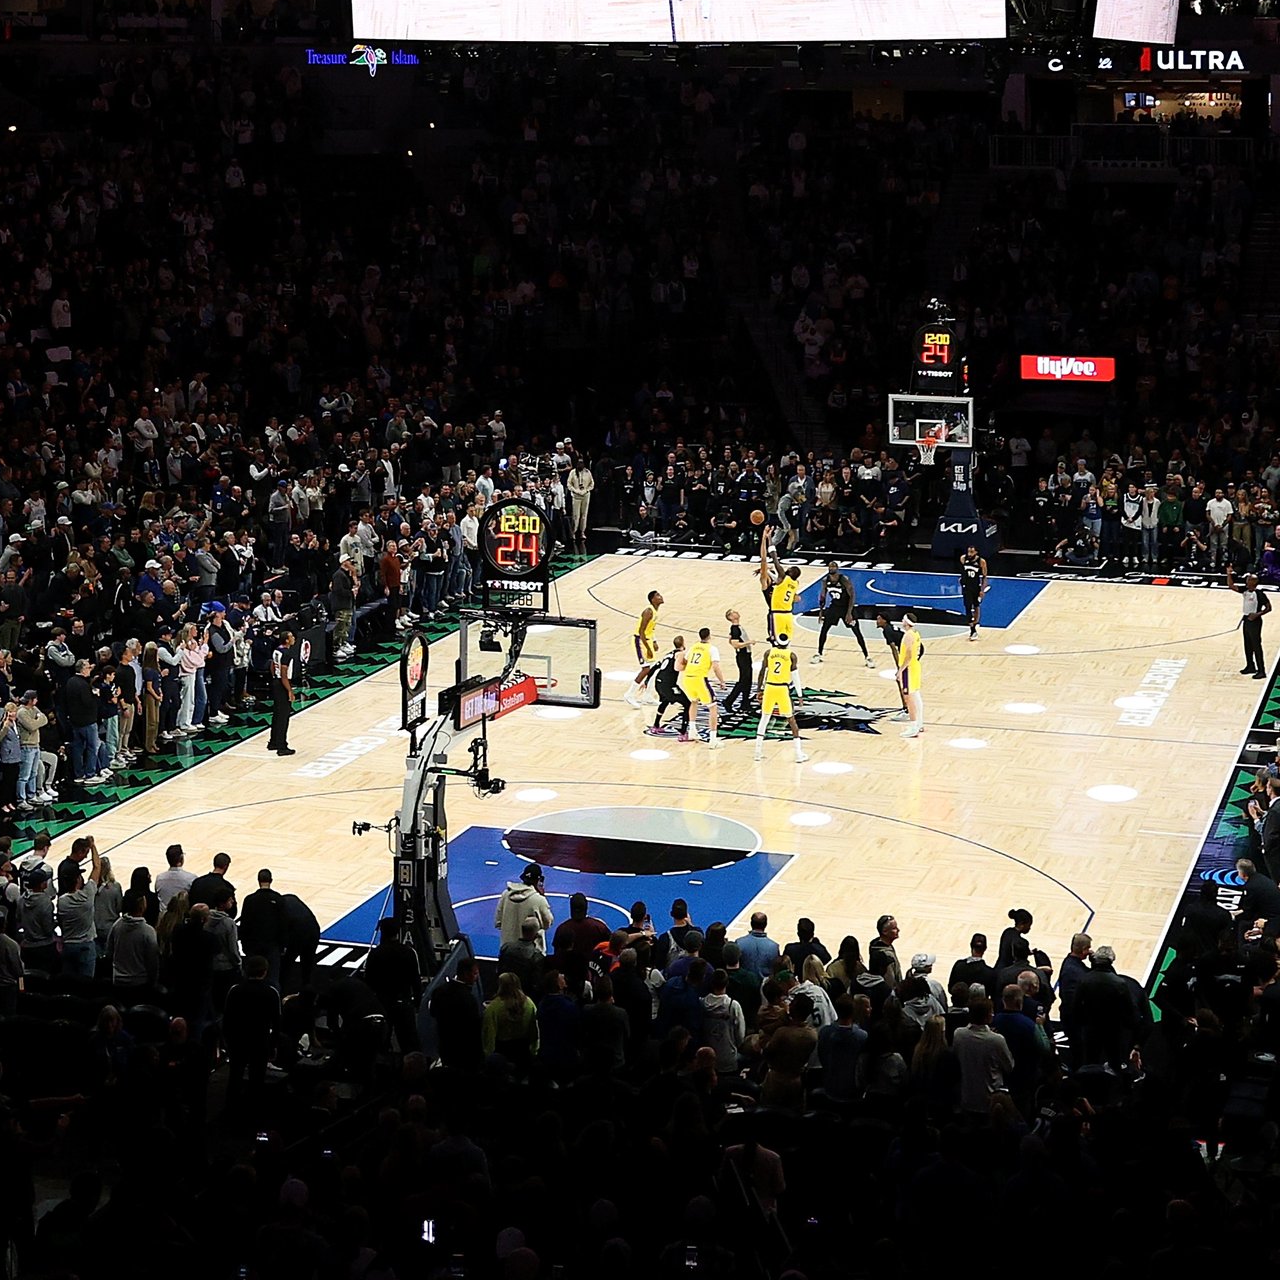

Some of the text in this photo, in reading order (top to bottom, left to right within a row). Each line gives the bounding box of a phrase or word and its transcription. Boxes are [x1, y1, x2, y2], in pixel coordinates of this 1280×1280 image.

[305, 48, 347, 64] Treasure
[1156, 50, 1245, 70] ULTRA
[922, 344, 948, 364] 24
[1037, 357, 1097, 378] HyVee
[500, 515, 540, 534] 12:00
[496, 532, 539, 566] 24
[502, 580, 544, 591] TISSOT
[690, 653, 701, 664] 12
[774, 662, 781, 673] 2
